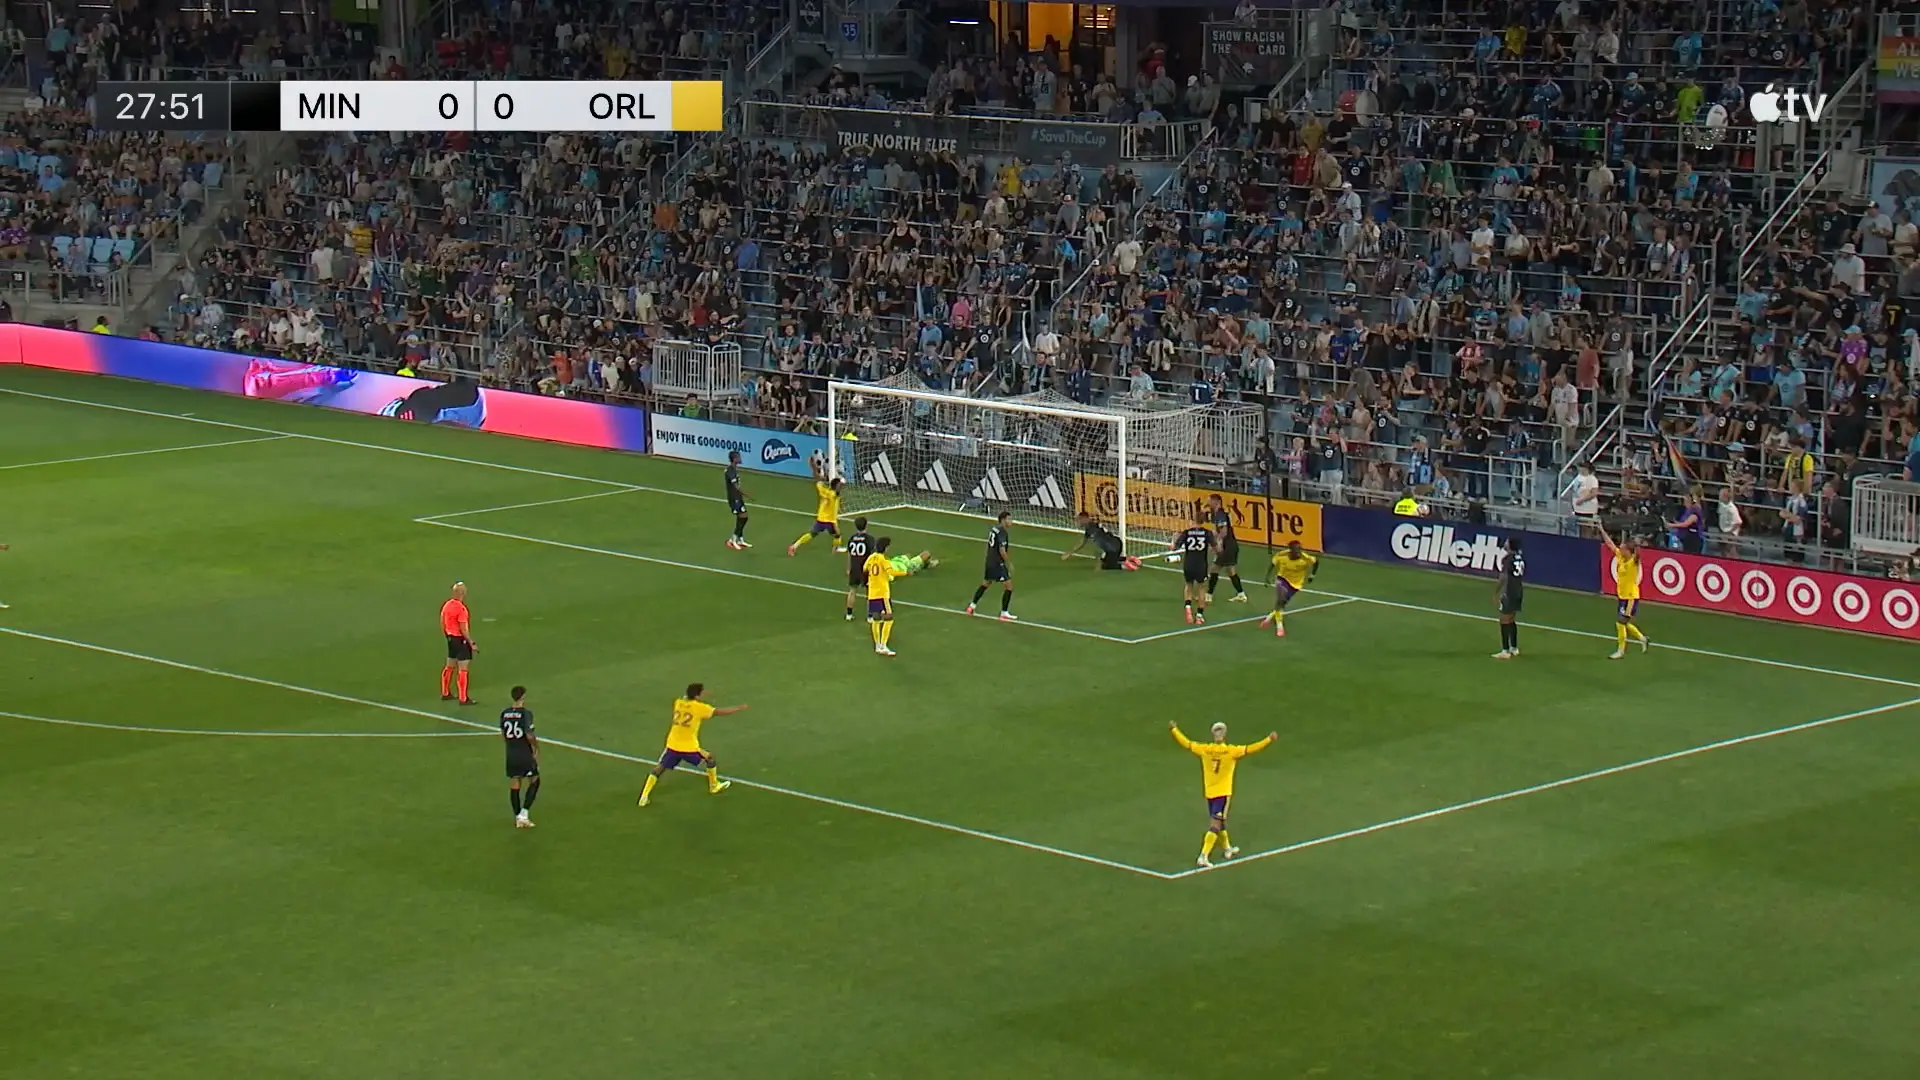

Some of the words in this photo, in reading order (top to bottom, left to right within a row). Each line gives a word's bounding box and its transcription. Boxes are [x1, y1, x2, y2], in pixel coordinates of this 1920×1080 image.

[843, 24, 857, 37] 35
[1212, 30, 1241, 42] SHOW
[1244, 31, 1285, 42] RACISM
[1212, 43, 1232, 54] THE
[1258, 44, 1286, 56] CARD
[837, 131, 869, 147] TRUE
[873, 134, 921, 152] NORTH
[924, 137, 957, 153] ELITE
[1030, 128, 1106, 147] #SaveTheCup
[656, 429, 680, 443] ENJOY
[681, 433, 696, 445] THE
[1244, 500, 1304, 536] Tire
[849, 542, 867, 556] 20
[1186, 536, 1206, 551] 23
[1391, 523, 1507, 571] Gillett
[1512, 560, 1525, 577] 30
[672, 710, 694, 728] 22
[504, 720, 524, 739] 26
[1211, 758, 1222, 775] 7
